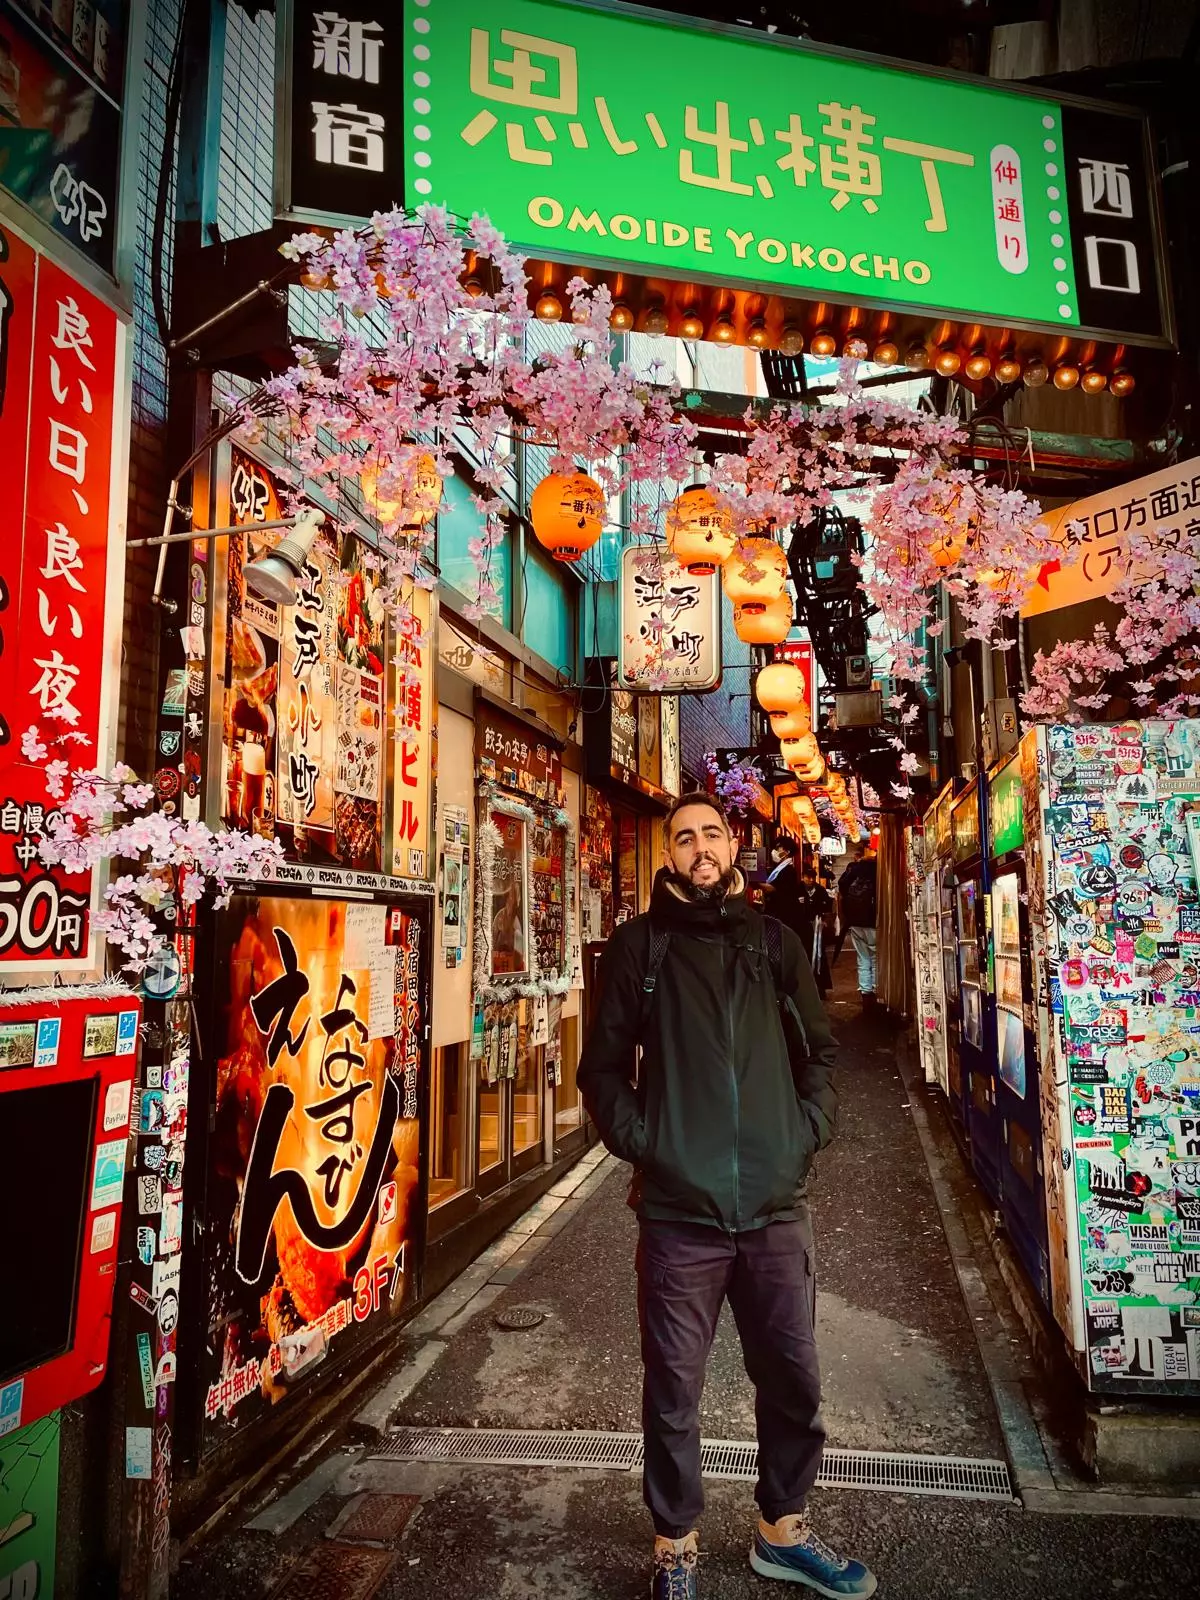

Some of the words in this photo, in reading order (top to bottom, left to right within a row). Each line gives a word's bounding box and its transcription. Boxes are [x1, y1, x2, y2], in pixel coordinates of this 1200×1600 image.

[312, 12, 384, 173] 新宿
[460, 27, 975, 232] 思い出横丁
[994, 159, 1022, 259] 仲通り
[1078, 157, 1140, 294] 西口
[527, 196, 713, 253] OMOIDE
[725, 228, 931, 285] YOKOCHO
[1057, 834, 1108, 849] SCARPA
[105, 1112, 127, 1126] PayPay
[1130, 1225, 1168, 1239] VISAH
[1153, 1252, 1185, 1265] FUNKY
[1155, 1265, 1187, 1283] MEL
[352, 1255, 389, 1322] 3F
[1164, 1345, 1177, 1378] VEGAN
[1176, 1351, 1188, 1373] DIET
